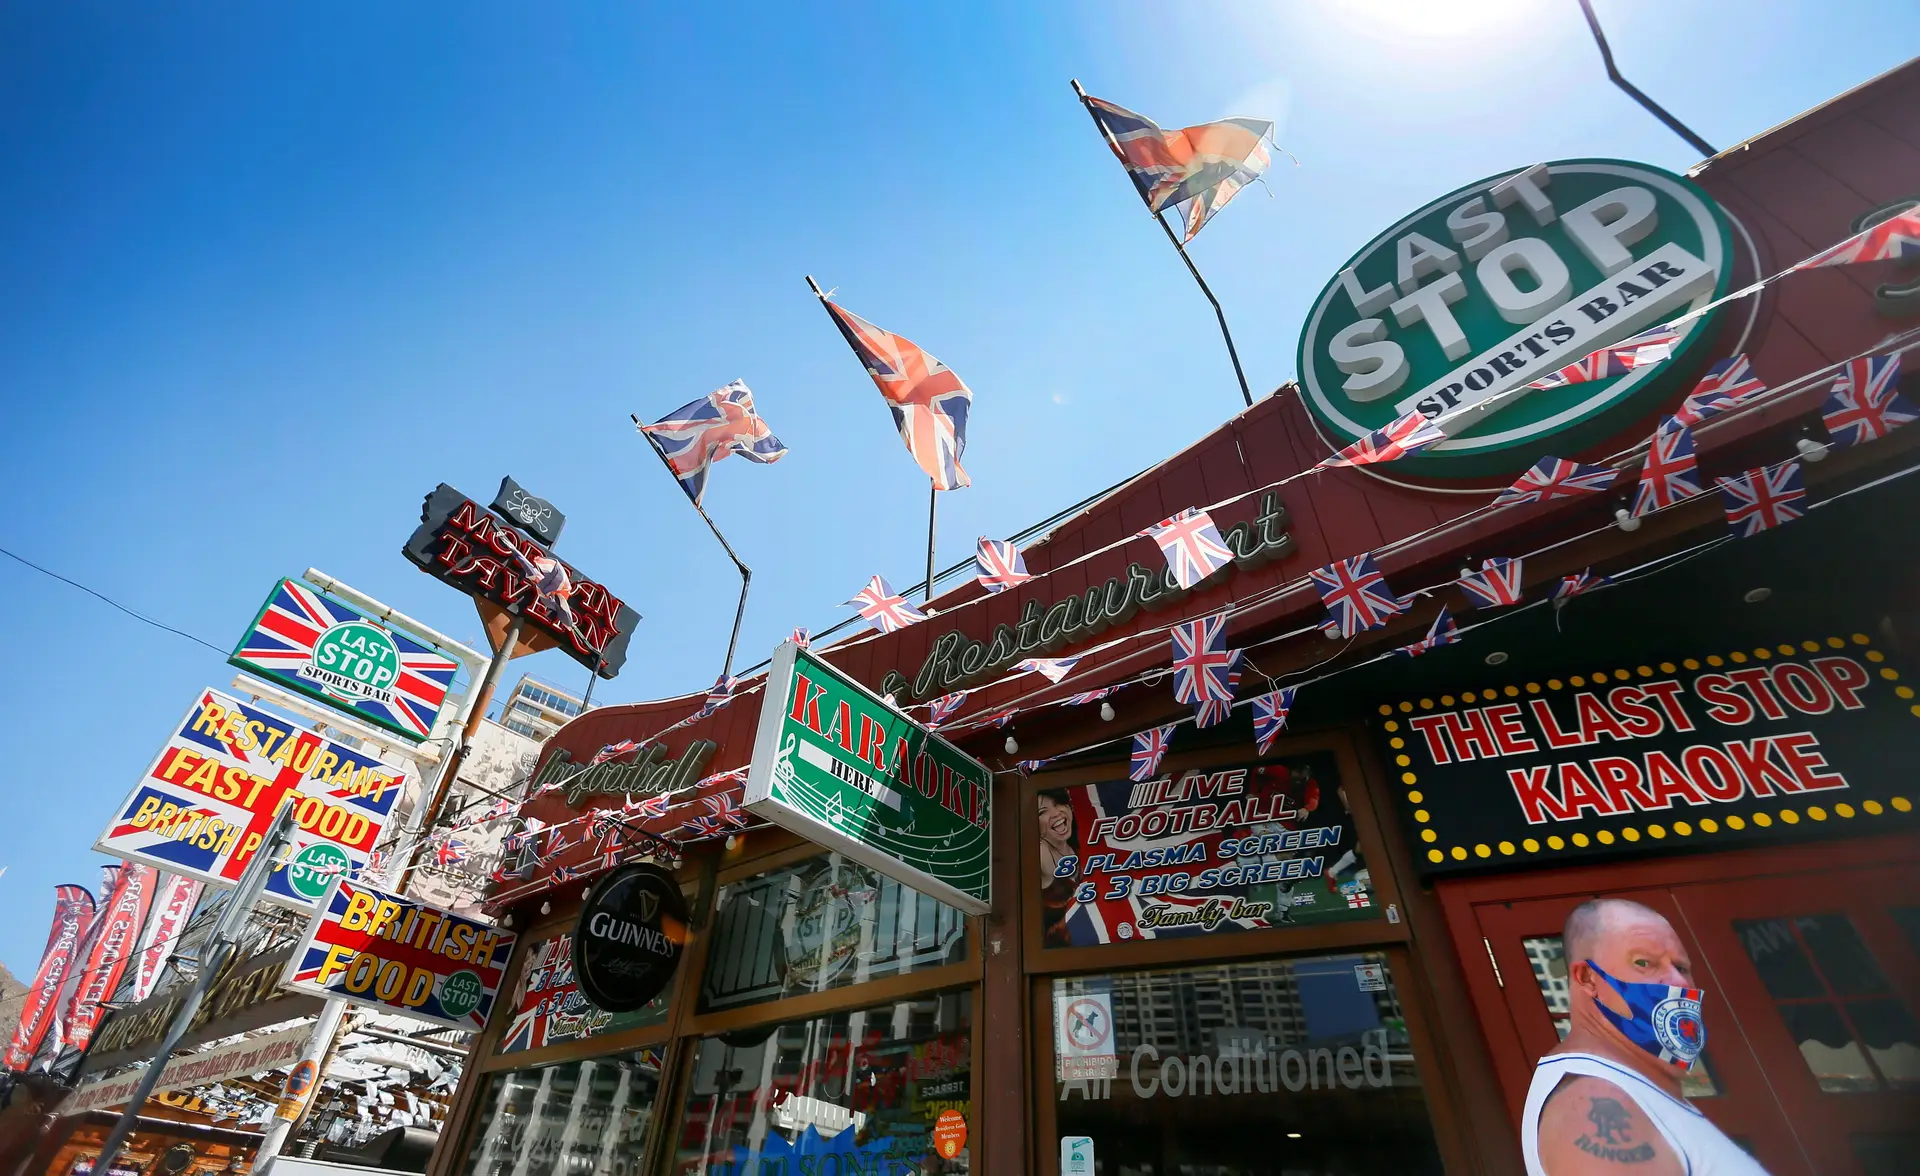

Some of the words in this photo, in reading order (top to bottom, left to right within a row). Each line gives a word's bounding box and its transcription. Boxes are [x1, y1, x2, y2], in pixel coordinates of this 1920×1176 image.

[1338, 162, 1558, 320] LAST
[1328, 185, 1660, 403] STOP
[1415, 319, 1577, 421] SPORTS
[1577, 260, 1686, 325] BAR
[452, 500, 626, 636] MORAN
[318, 642, 393, 686] STOP
[339, 628, 394, 663] LAST
[303, 665, 360, 691] SPORTS
[362, 685, 392, 703] BAR
[1408, 704, 1540, 766] THE
[1530, 680, 1698, 752] LAST
[1694, 655, 1871, 726] STOP
[191, 701, 396, 806] RESTAURANT
[789, 671, 988, 831] KARAOKE
[163, 751, 273, 810] FAST
[830, 757, 876, 797] HERE
[1156, 768, 1248, 806] LIVE
[1507, 731, 1850, 825] KARAOKE
[130, 796, 243, 856] BRITISH
[1087, 794, 1298, 845] FOOTBALL
[291, 861, 331, 886] STO
[1053, 854, 1079, 878] 8
[1083, 842, 1207, 875] PLASMA
[1216, 825, 1342, 858] SCREEN
[1104, 875, 1132, 900] 3
[1139, 872, 1190, 896] BIG
[1199, 856, 1325, 889] SCREEN
[338, 891, 501, 969] BRITISH
[589, 911, 677, 959] GUINNESS
[1138, 897, 1226, 932] Family
[1229, 897, 1273, 921] bar
[315, 943, 437, 1008] FOOD
[441, 987, 481, 1008] STOP
[451, 976, 479, 993] LAST
[535, 969, 551, 992] 8
[546, 970, 576, 990] PLA
[546, 990, 563, 1016] 3
[548, 1009, 592, 1039] Family
[1131, 1028, 1392, 1099] Conditioned
